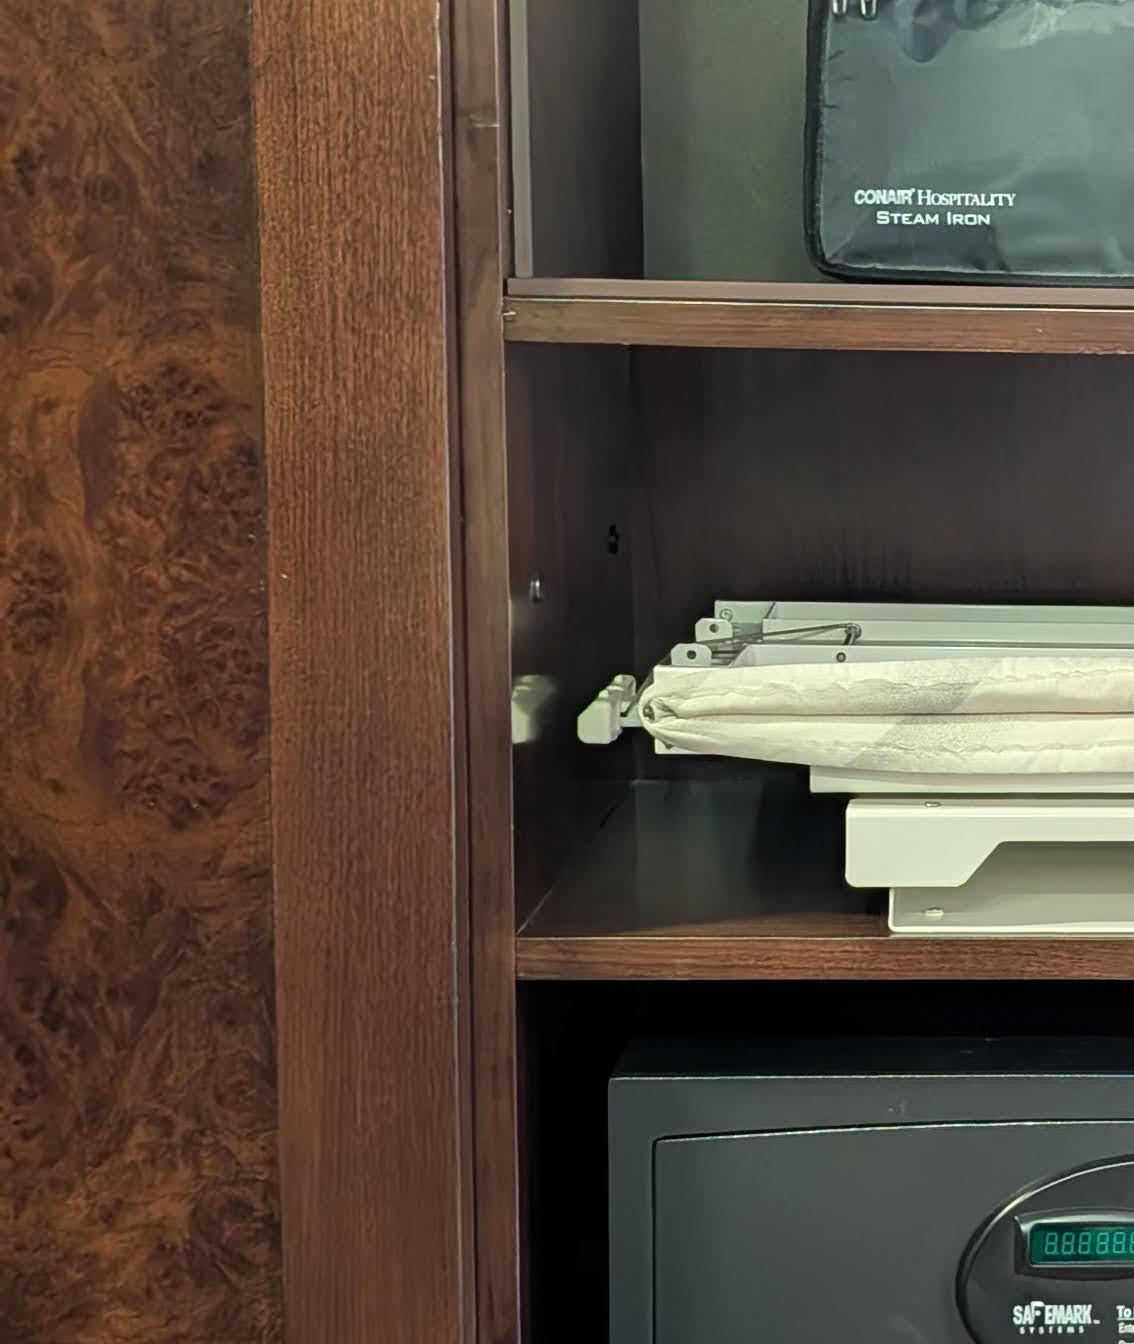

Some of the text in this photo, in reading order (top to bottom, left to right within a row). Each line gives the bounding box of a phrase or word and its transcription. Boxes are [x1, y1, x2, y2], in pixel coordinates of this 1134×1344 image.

[876, 210, 991, 226] STEAM IRON
[1013, 1300, 1093, 1325] SAFEMARK
[1115, 1305, 1132, 1320] To
